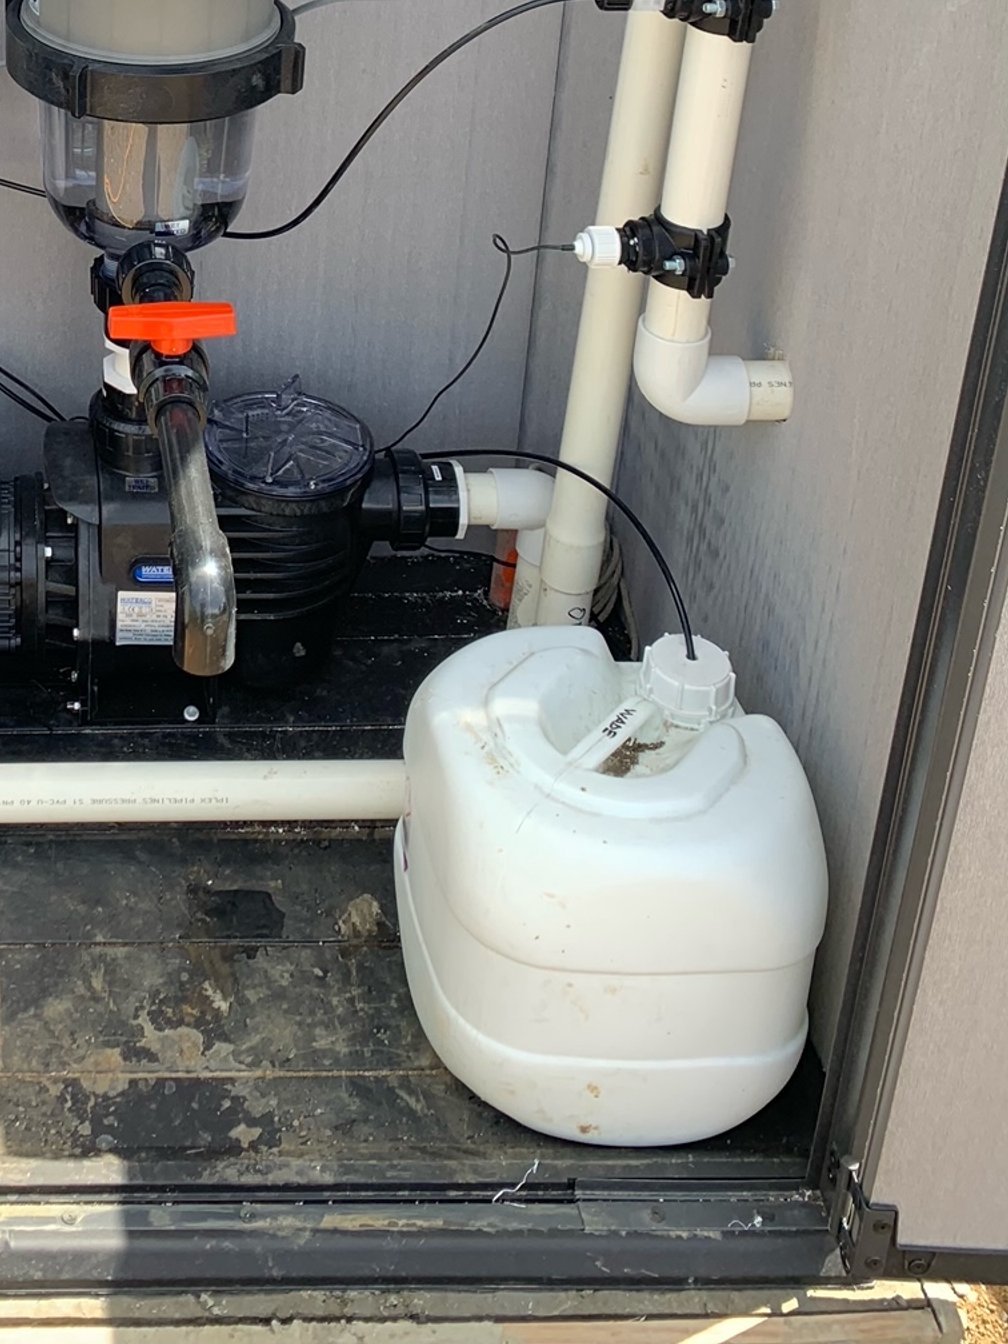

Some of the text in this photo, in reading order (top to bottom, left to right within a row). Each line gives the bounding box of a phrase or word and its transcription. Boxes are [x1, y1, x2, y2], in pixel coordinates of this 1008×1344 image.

[602, 708, 637, 738] WADE
[142, 797, 195, 805] PIPELINES
[200, 797, 229, 805] IPLEX
